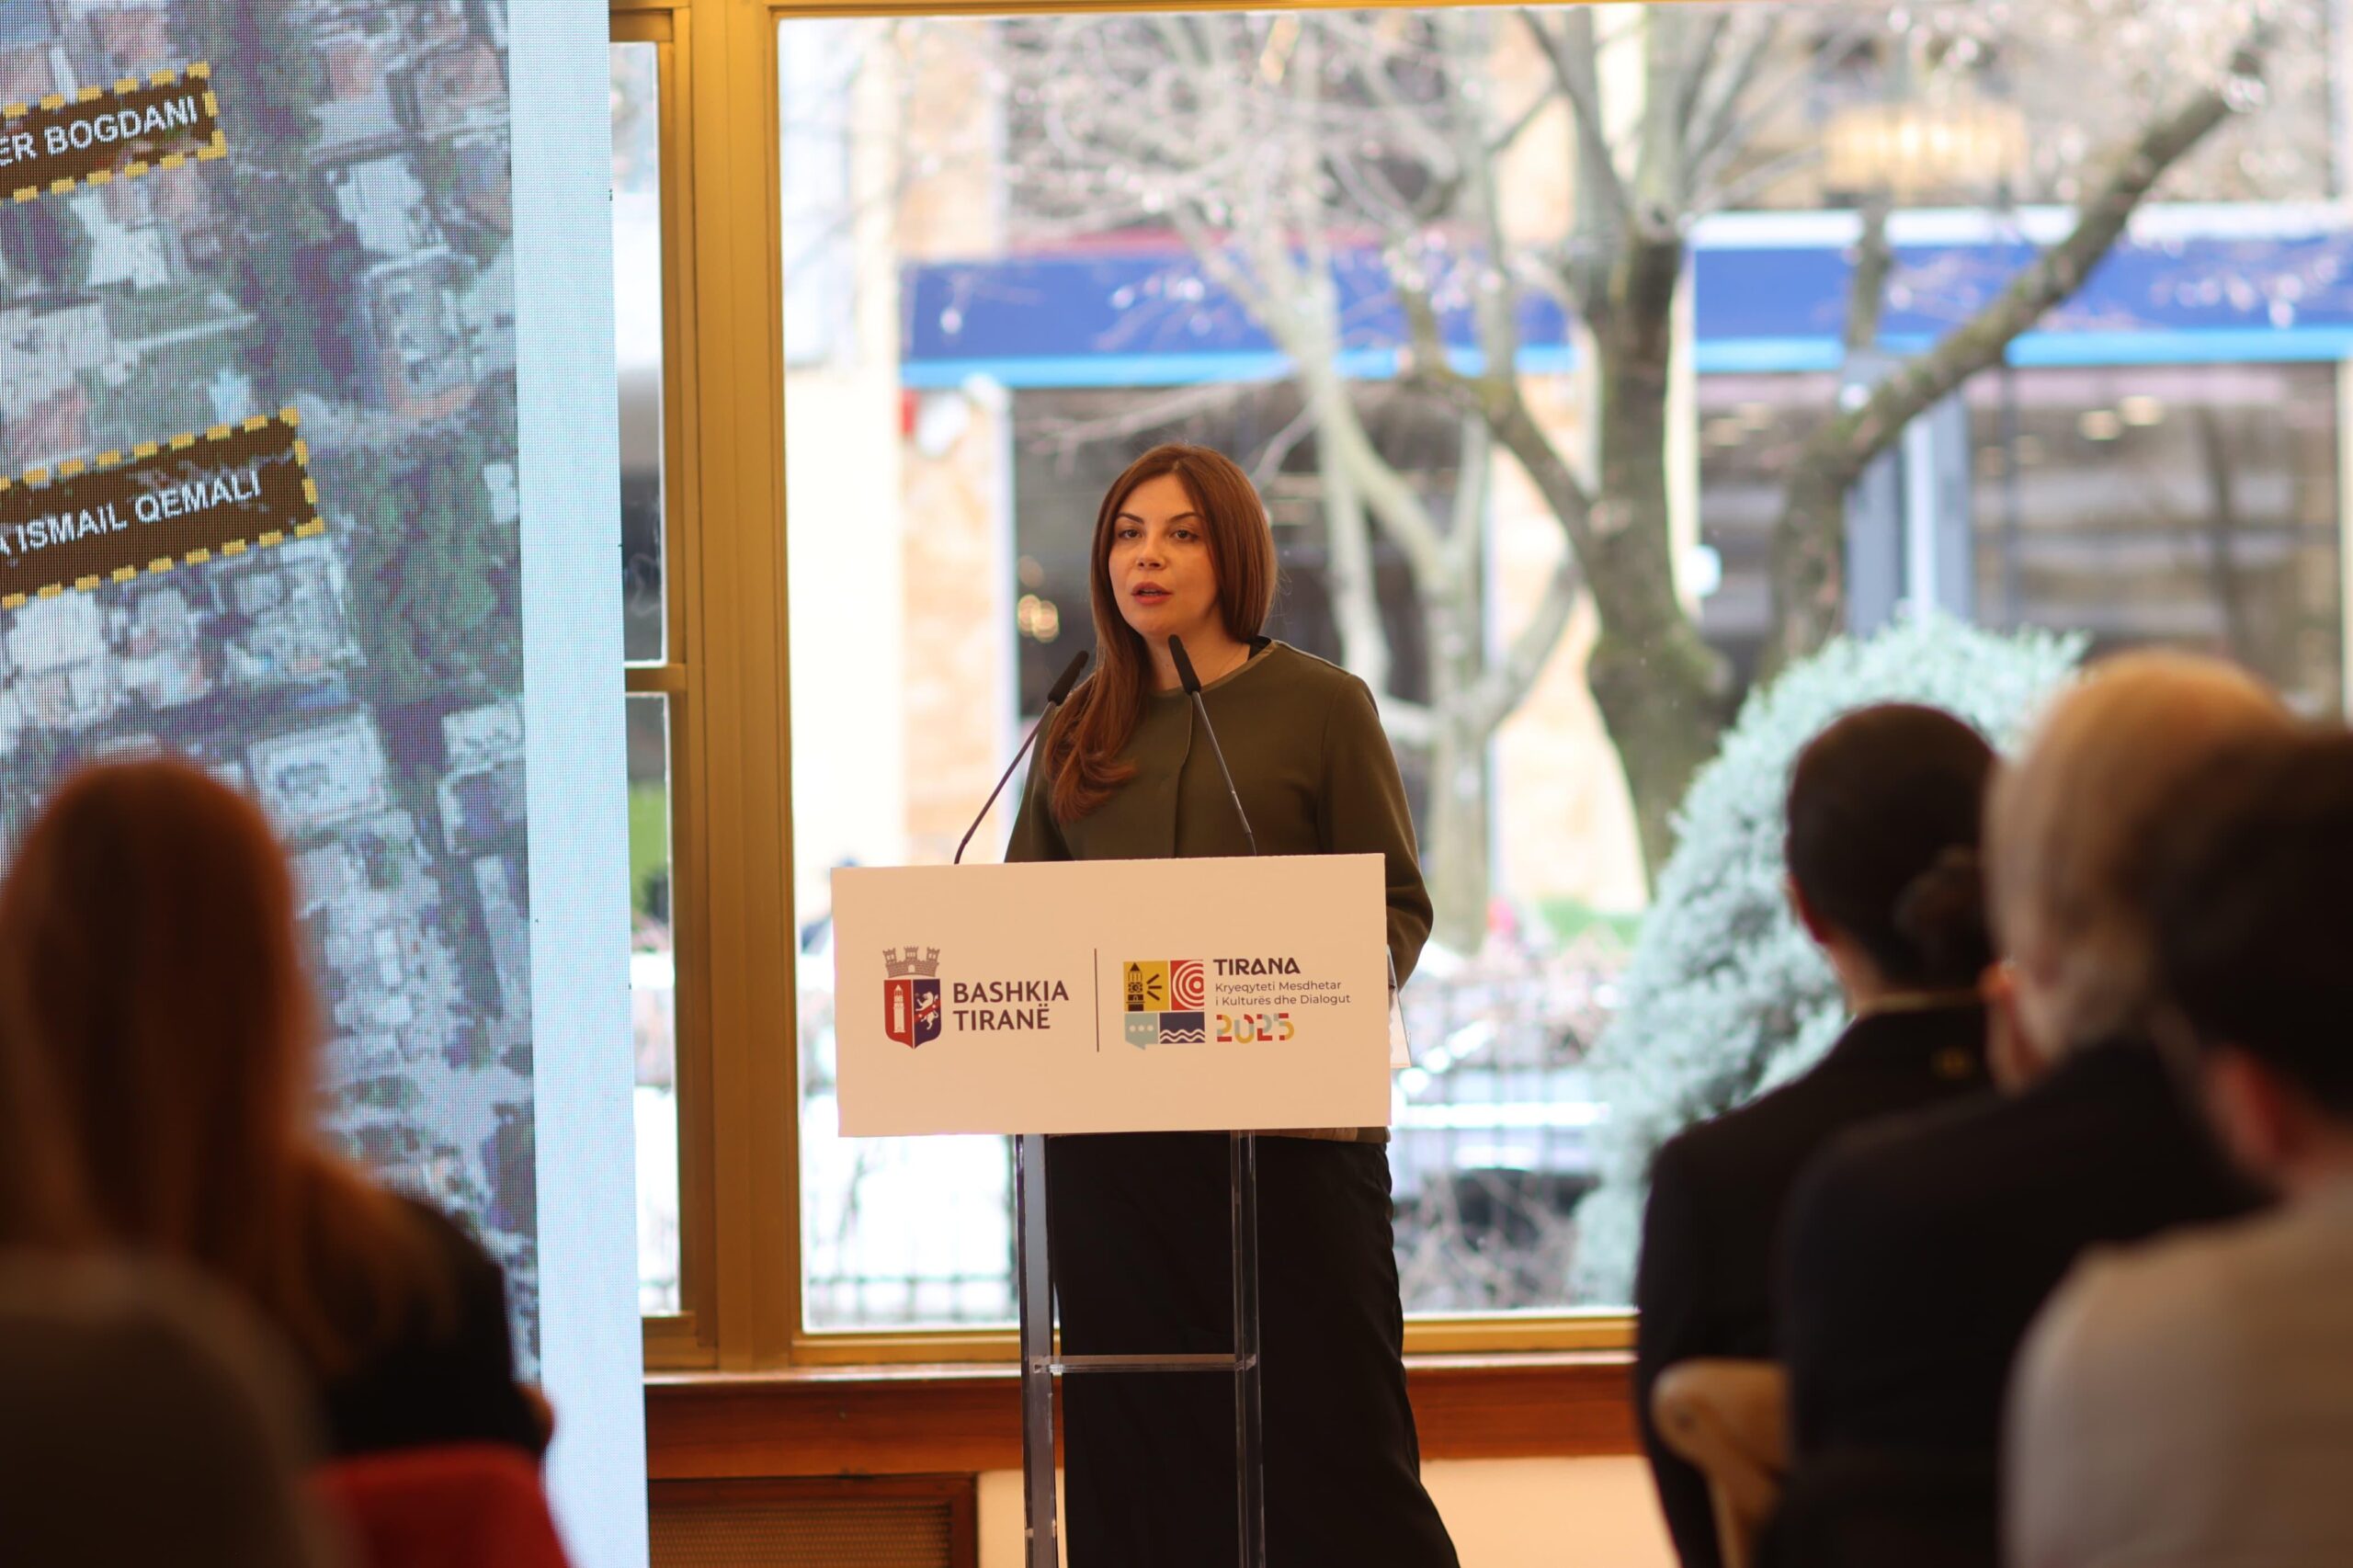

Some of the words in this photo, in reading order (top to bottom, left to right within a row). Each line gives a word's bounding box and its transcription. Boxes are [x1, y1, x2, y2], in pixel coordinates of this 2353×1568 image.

[44, 96, 198, 156] BOGDANI
[16, 503, 128, 553] ISMAIL
[134, 470, 262, 523] QEMALI
[1212, 957, 1301, 976] TIRANA
[952, 980, 1069, 1004] BASHKIA
[1215, 982, 1275, 994] Kryeqyteti
[1279, 981, 1341, 991] Mesdhetar
[1222, 994, 1271, 1006] Kulturës
[1274, 994, 1297, 1005] dhe
[1300, 994, 1351, 1006] Dialogut
[952, 1003, 1051, 1031] TIRANË
[1216, 1012, 1295, 1044] 2025
